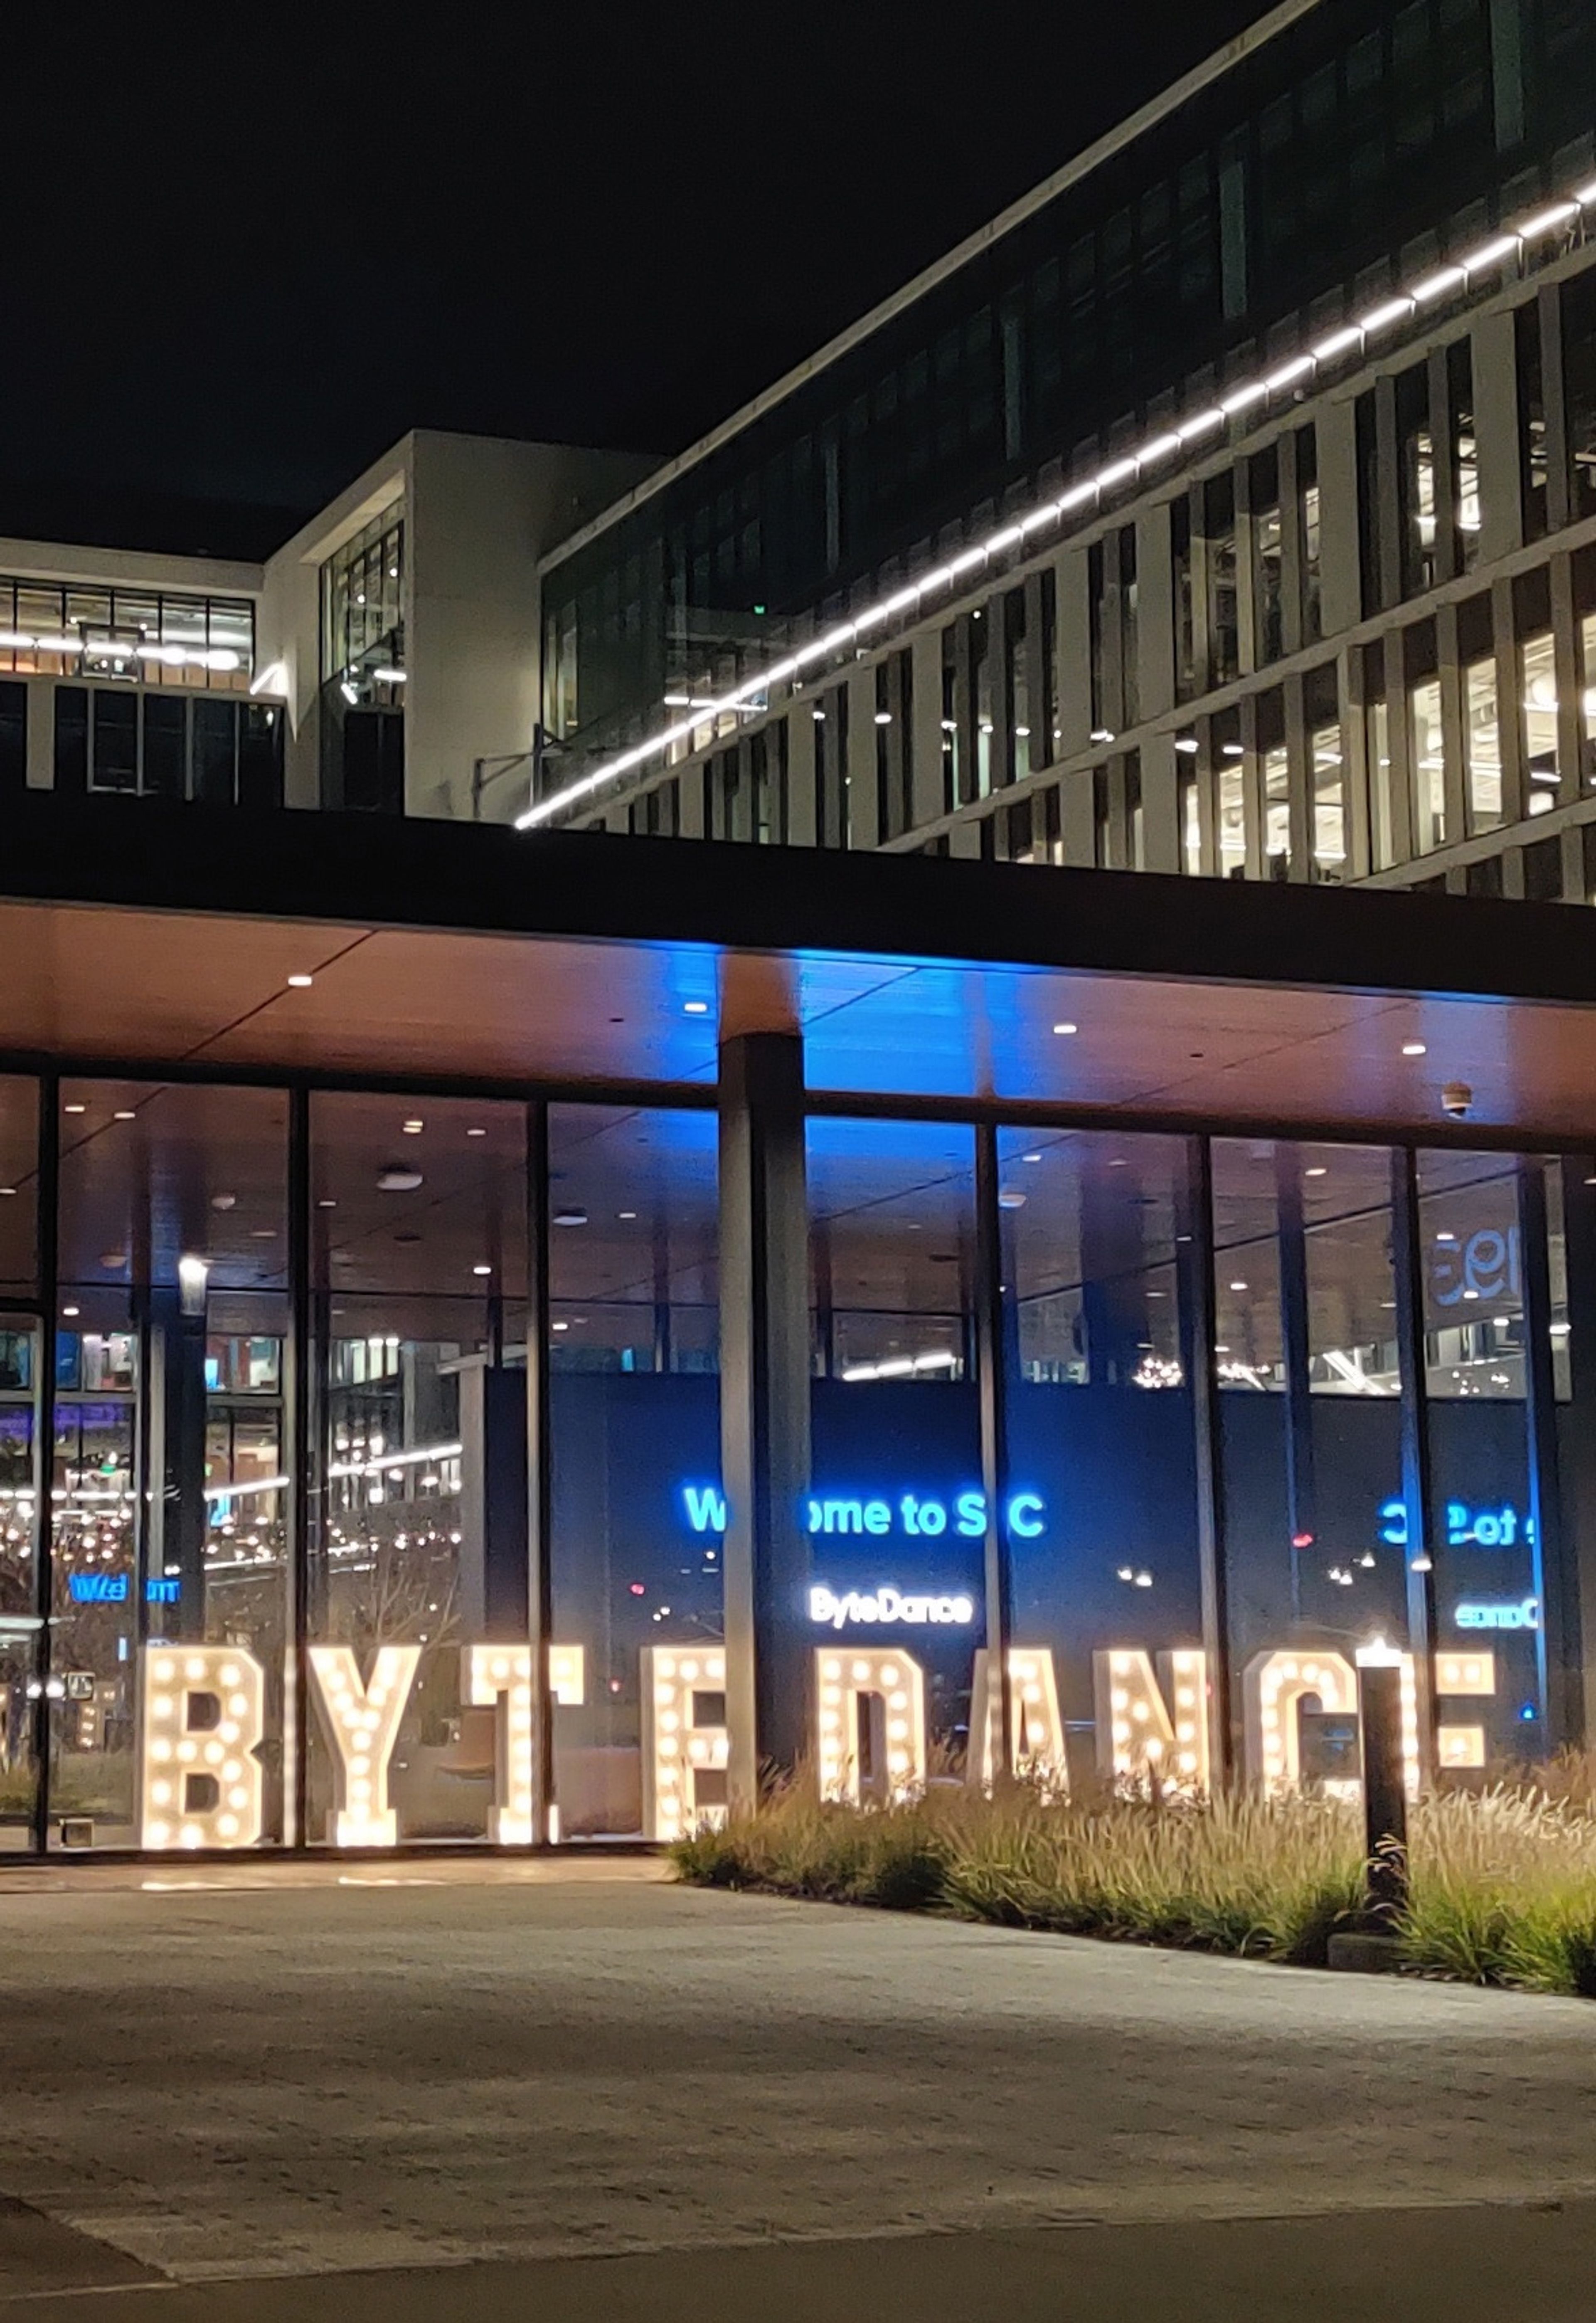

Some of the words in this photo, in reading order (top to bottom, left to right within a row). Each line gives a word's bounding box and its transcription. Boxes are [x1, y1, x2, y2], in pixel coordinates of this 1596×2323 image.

[901, 1495, 946, 1535] to
[957, 1492, 1043, 1537] SC
[809, 1586, 974, 1629] ByteDance
